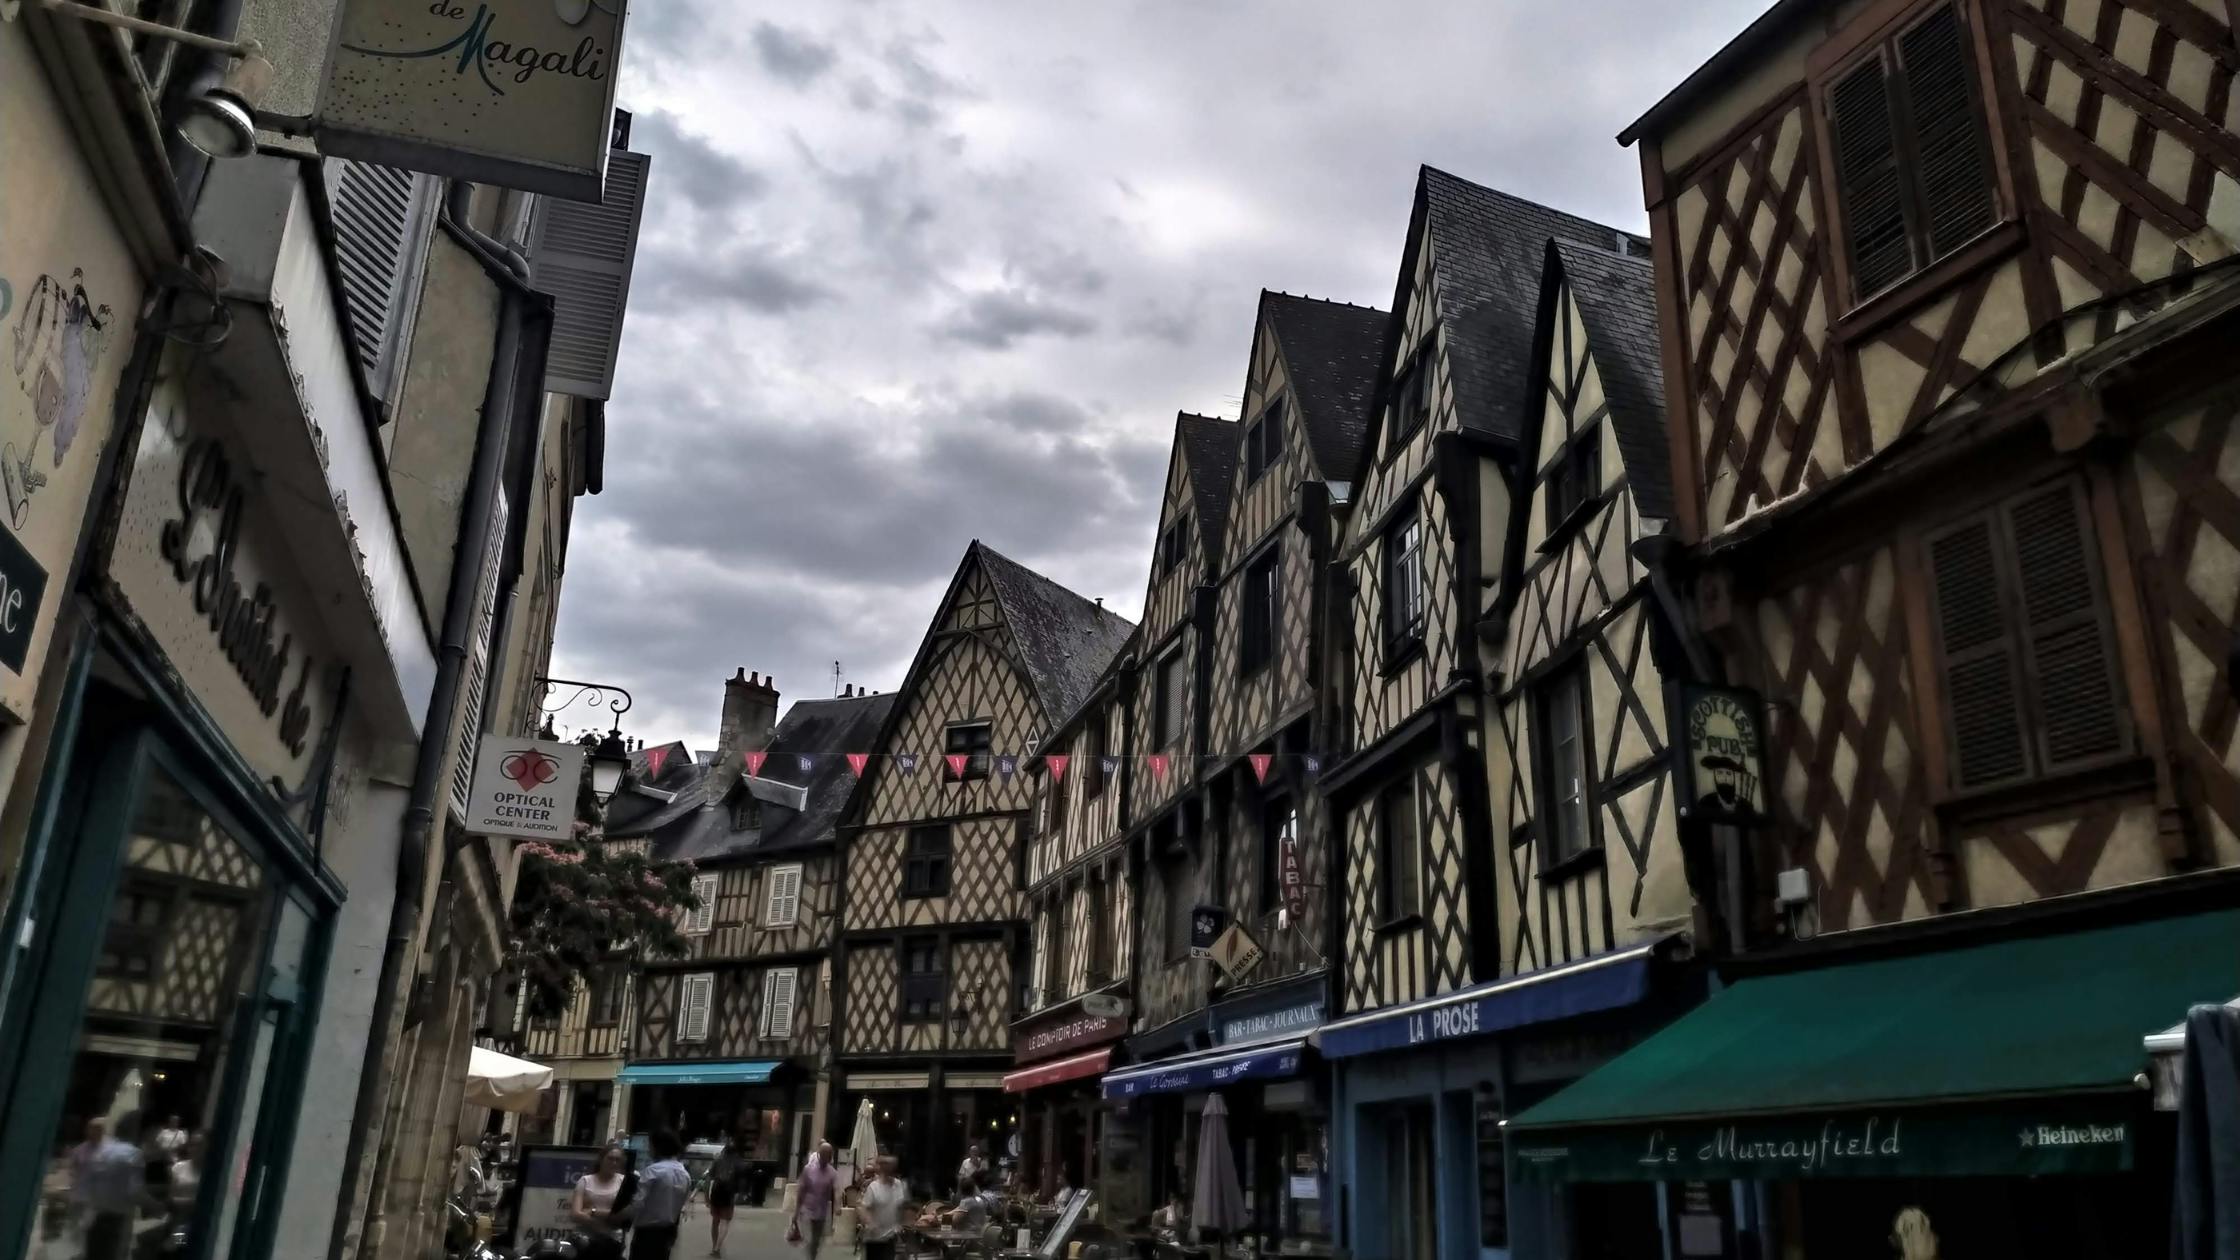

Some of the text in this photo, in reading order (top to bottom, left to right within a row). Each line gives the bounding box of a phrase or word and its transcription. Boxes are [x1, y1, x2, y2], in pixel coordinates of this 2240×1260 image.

[430, 0, 465, 20] de
[1690, 697, 1757, 756] SCOTTISH
[1706, 735, 1742, 755] PUB
[494, 791, 556, 809] OPTICAL
[483, 818, 514, 828] OPTIQUE
[523, 822, 559, 832] AUDITION
[495, 805, 551, 821] CENTER
[1285, 840, 1302, 916] TABAC
[1231, 949, 1259, 977] PRESSE
[1028, 1016, 1107, 1051] LE COMPTOIR DE PARIS
[1409, 1001, 1480, 1044] LA PROSE
[1637, 1115, 1902, 1170] Le Murrayfield
[2036, 1123, 2125, 1146] Heineken
